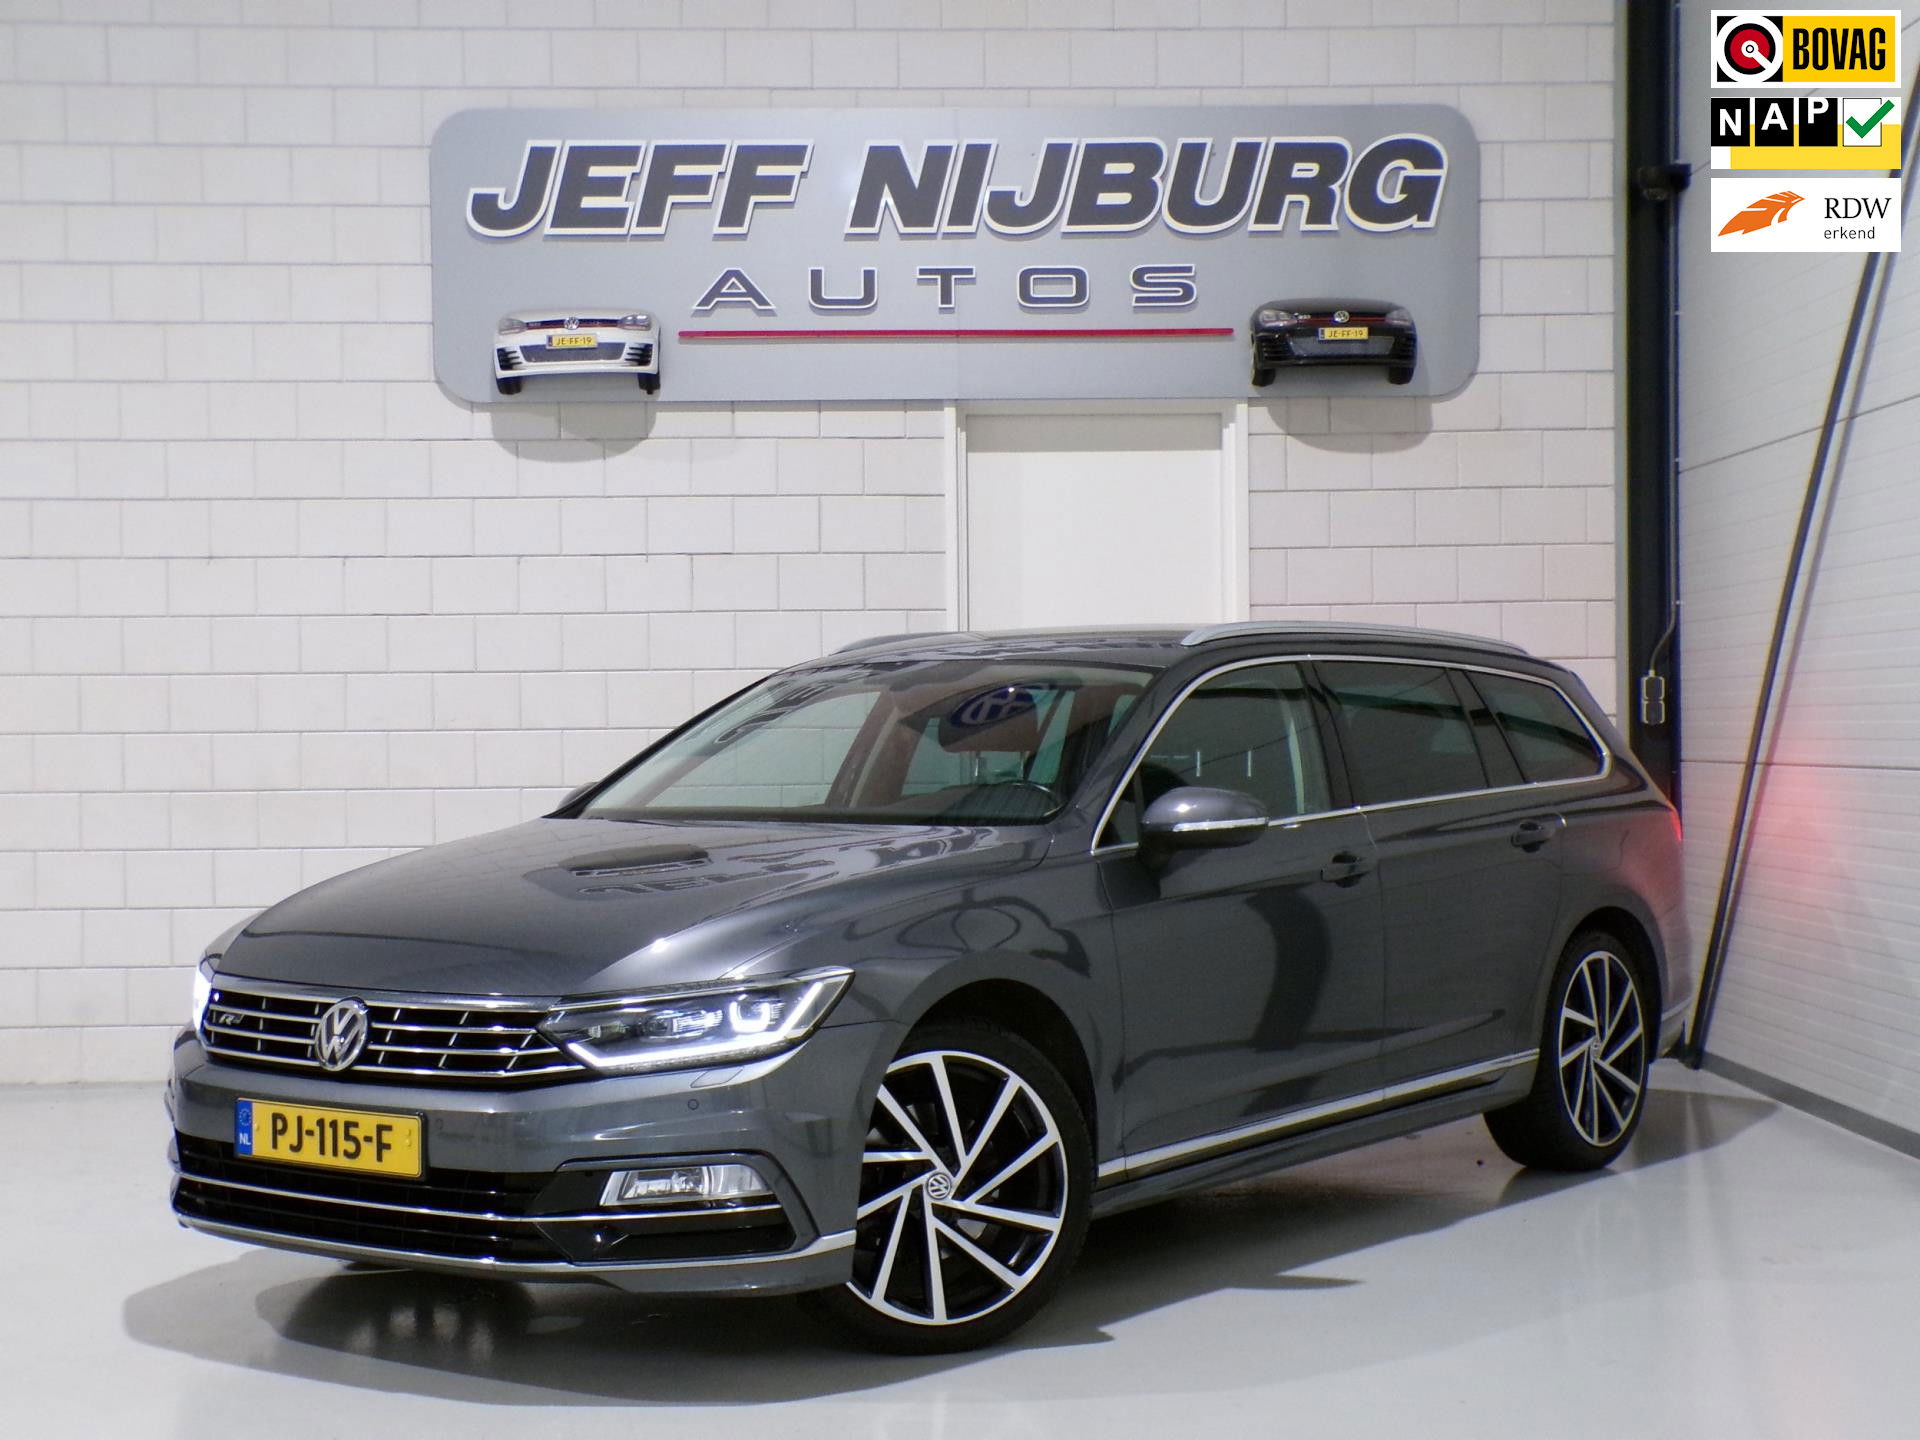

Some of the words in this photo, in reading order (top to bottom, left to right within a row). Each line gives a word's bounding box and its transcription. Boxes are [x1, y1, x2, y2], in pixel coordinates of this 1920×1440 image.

[466, 139, 814, 238] JEFF
[844, 134, 1449, 235] NIJBURG
[692, 265, 1198, 310] AUTOS
[555, 336, 593, 346] JE-FF-19
[239, 1132, 252, 1146] NL
[271, 1111, 394, 1163] PJ-115-F
